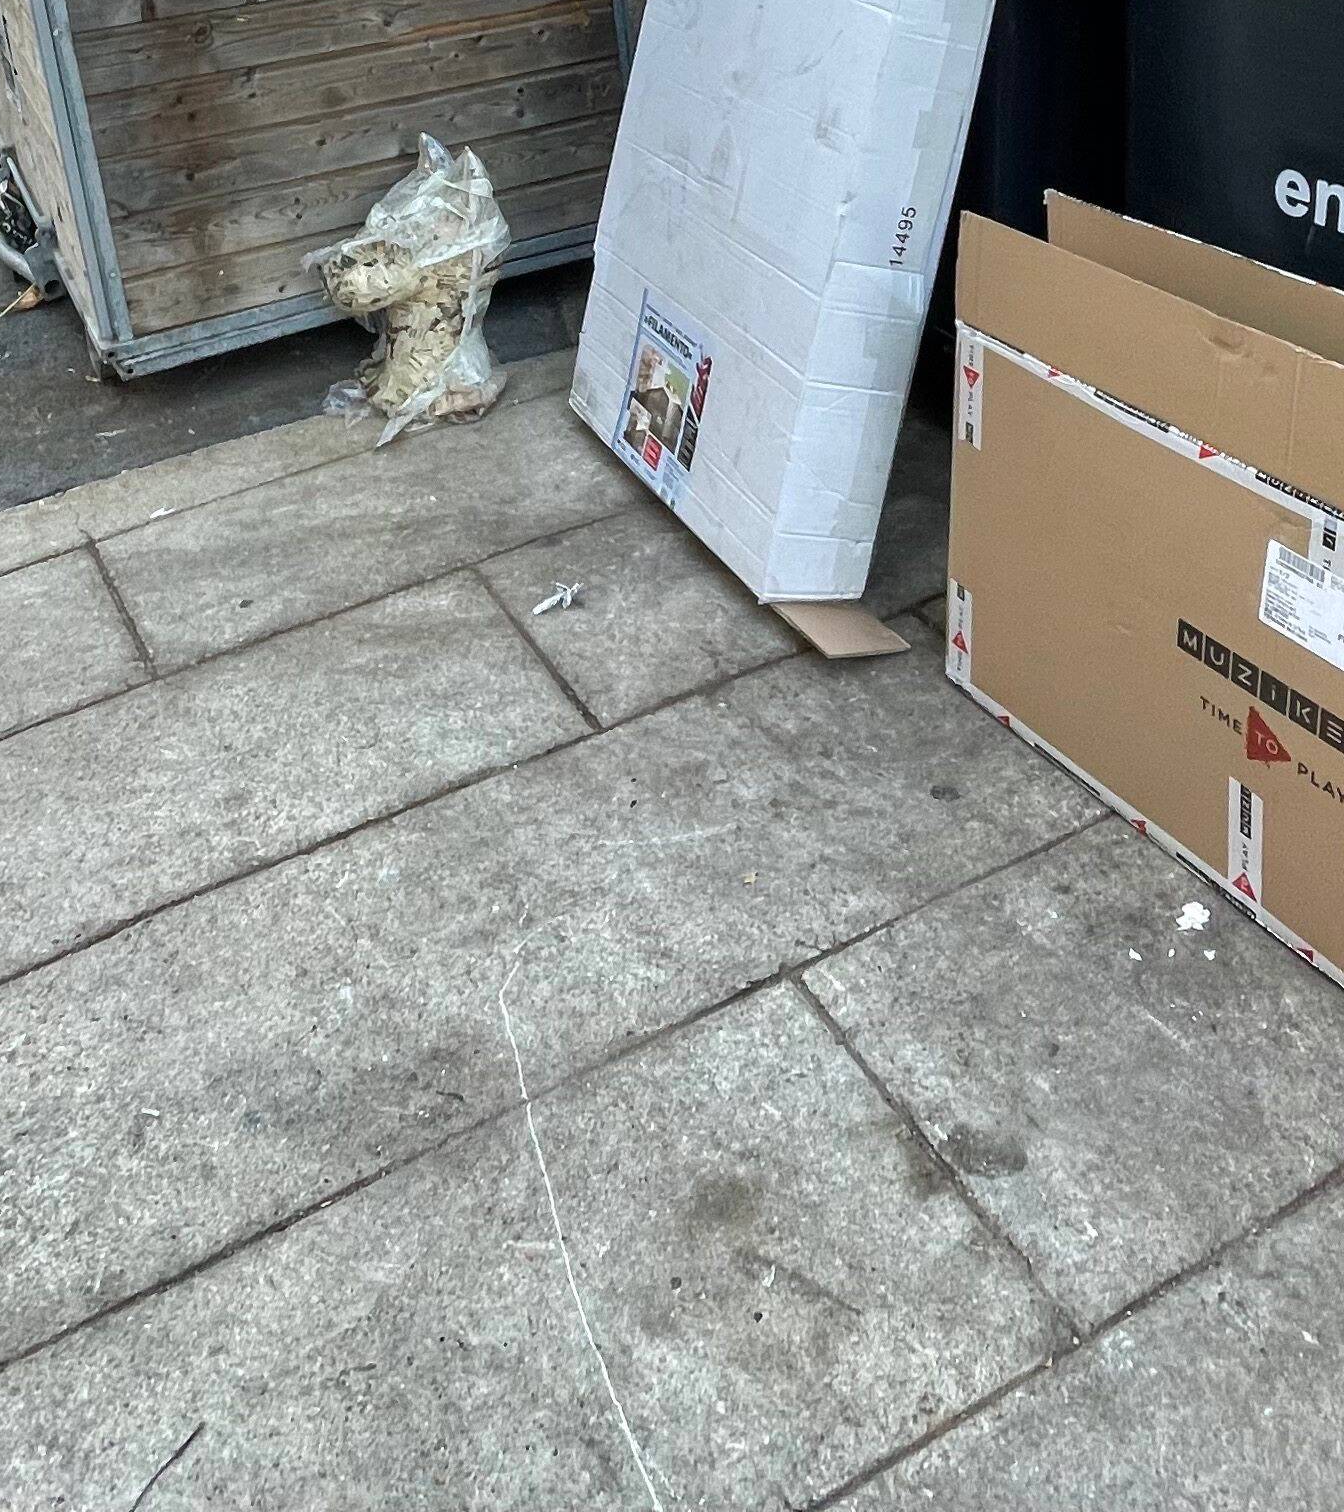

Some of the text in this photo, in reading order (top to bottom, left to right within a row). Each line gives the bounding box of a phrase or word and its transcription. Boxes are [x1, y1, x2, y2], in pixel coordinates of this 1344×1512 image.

[889, 207, 917, 266] 14495
[1200, 695, 1243, 736] TIME
[1254, 733, 1280, 756] TO
